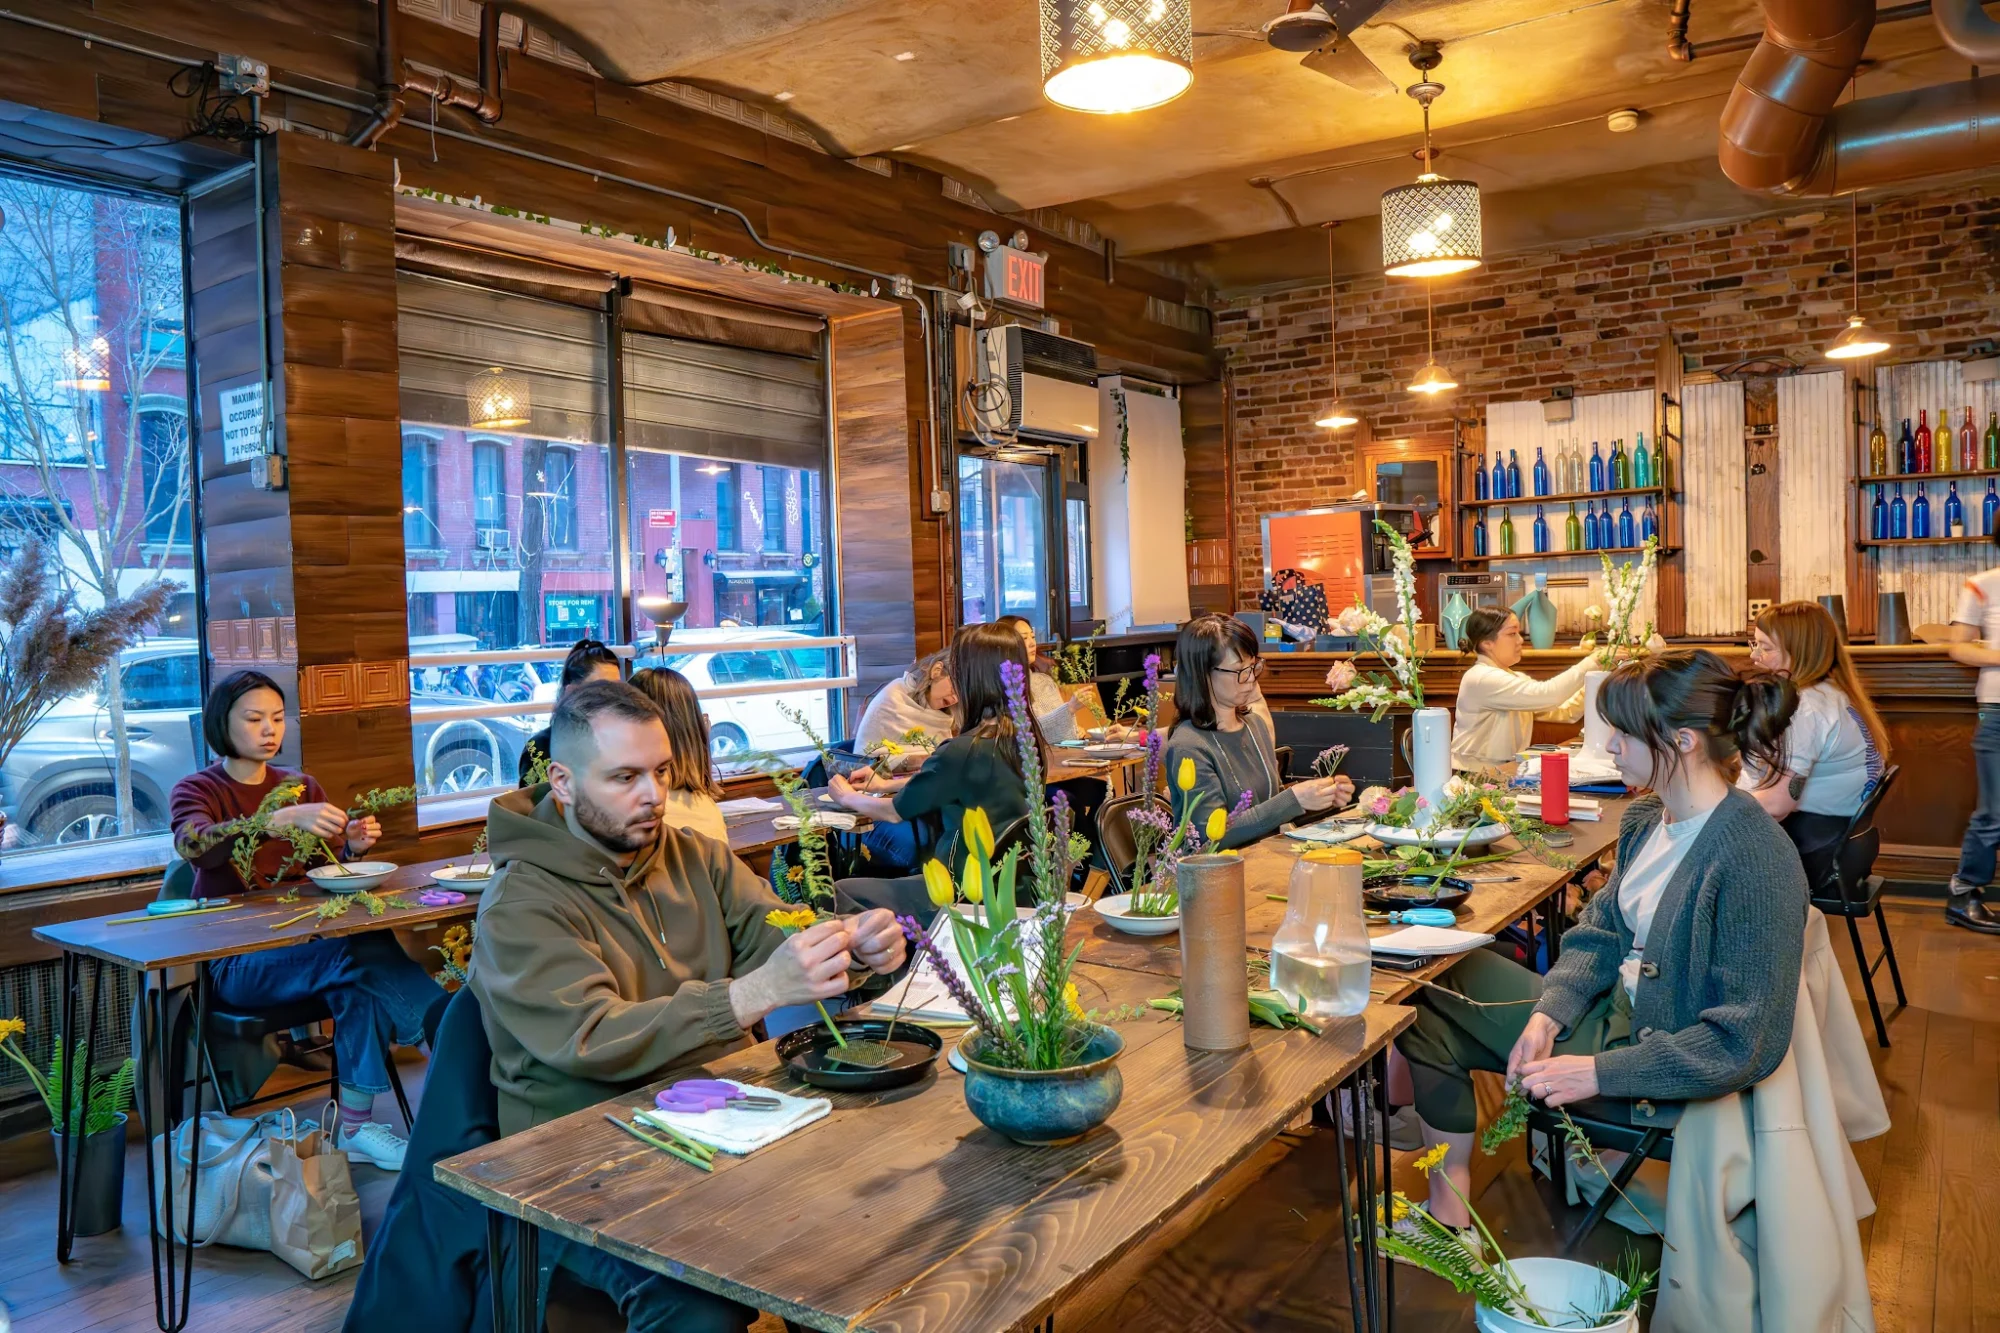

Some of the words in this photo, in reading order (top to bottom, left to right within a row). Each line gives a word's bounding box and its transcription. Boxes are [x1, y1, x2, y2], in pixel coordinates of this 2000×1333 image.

[1008, 255, 1042, 304] EXIT
[229, 407, 264, 423] OCCUPANC
[225, 430, 239, 441] NOT
[240, 427, 249, 438] TO
